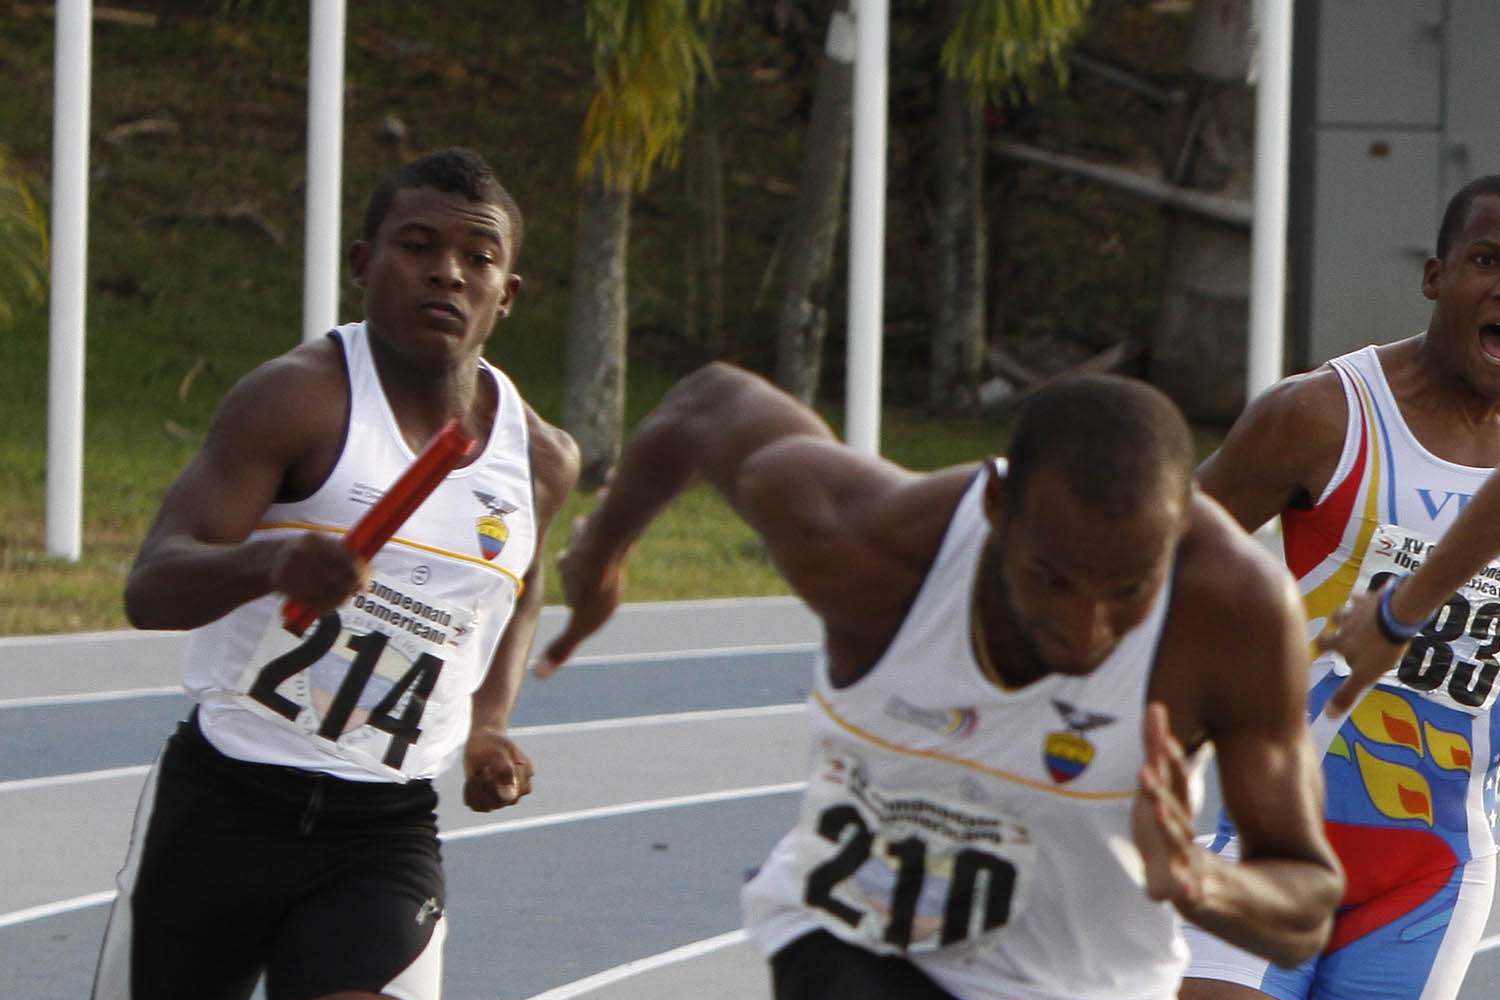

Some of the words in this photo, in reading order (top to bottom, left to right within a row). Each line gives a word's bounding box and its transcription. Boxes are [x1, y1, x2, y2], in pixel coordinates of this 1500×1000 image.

[353, 594, 447, 645] oamericano
[370, 580, 451, 627] ampeonato
[249, 606, 445, 770] 214
[804, 803, 1017, 950] 210
